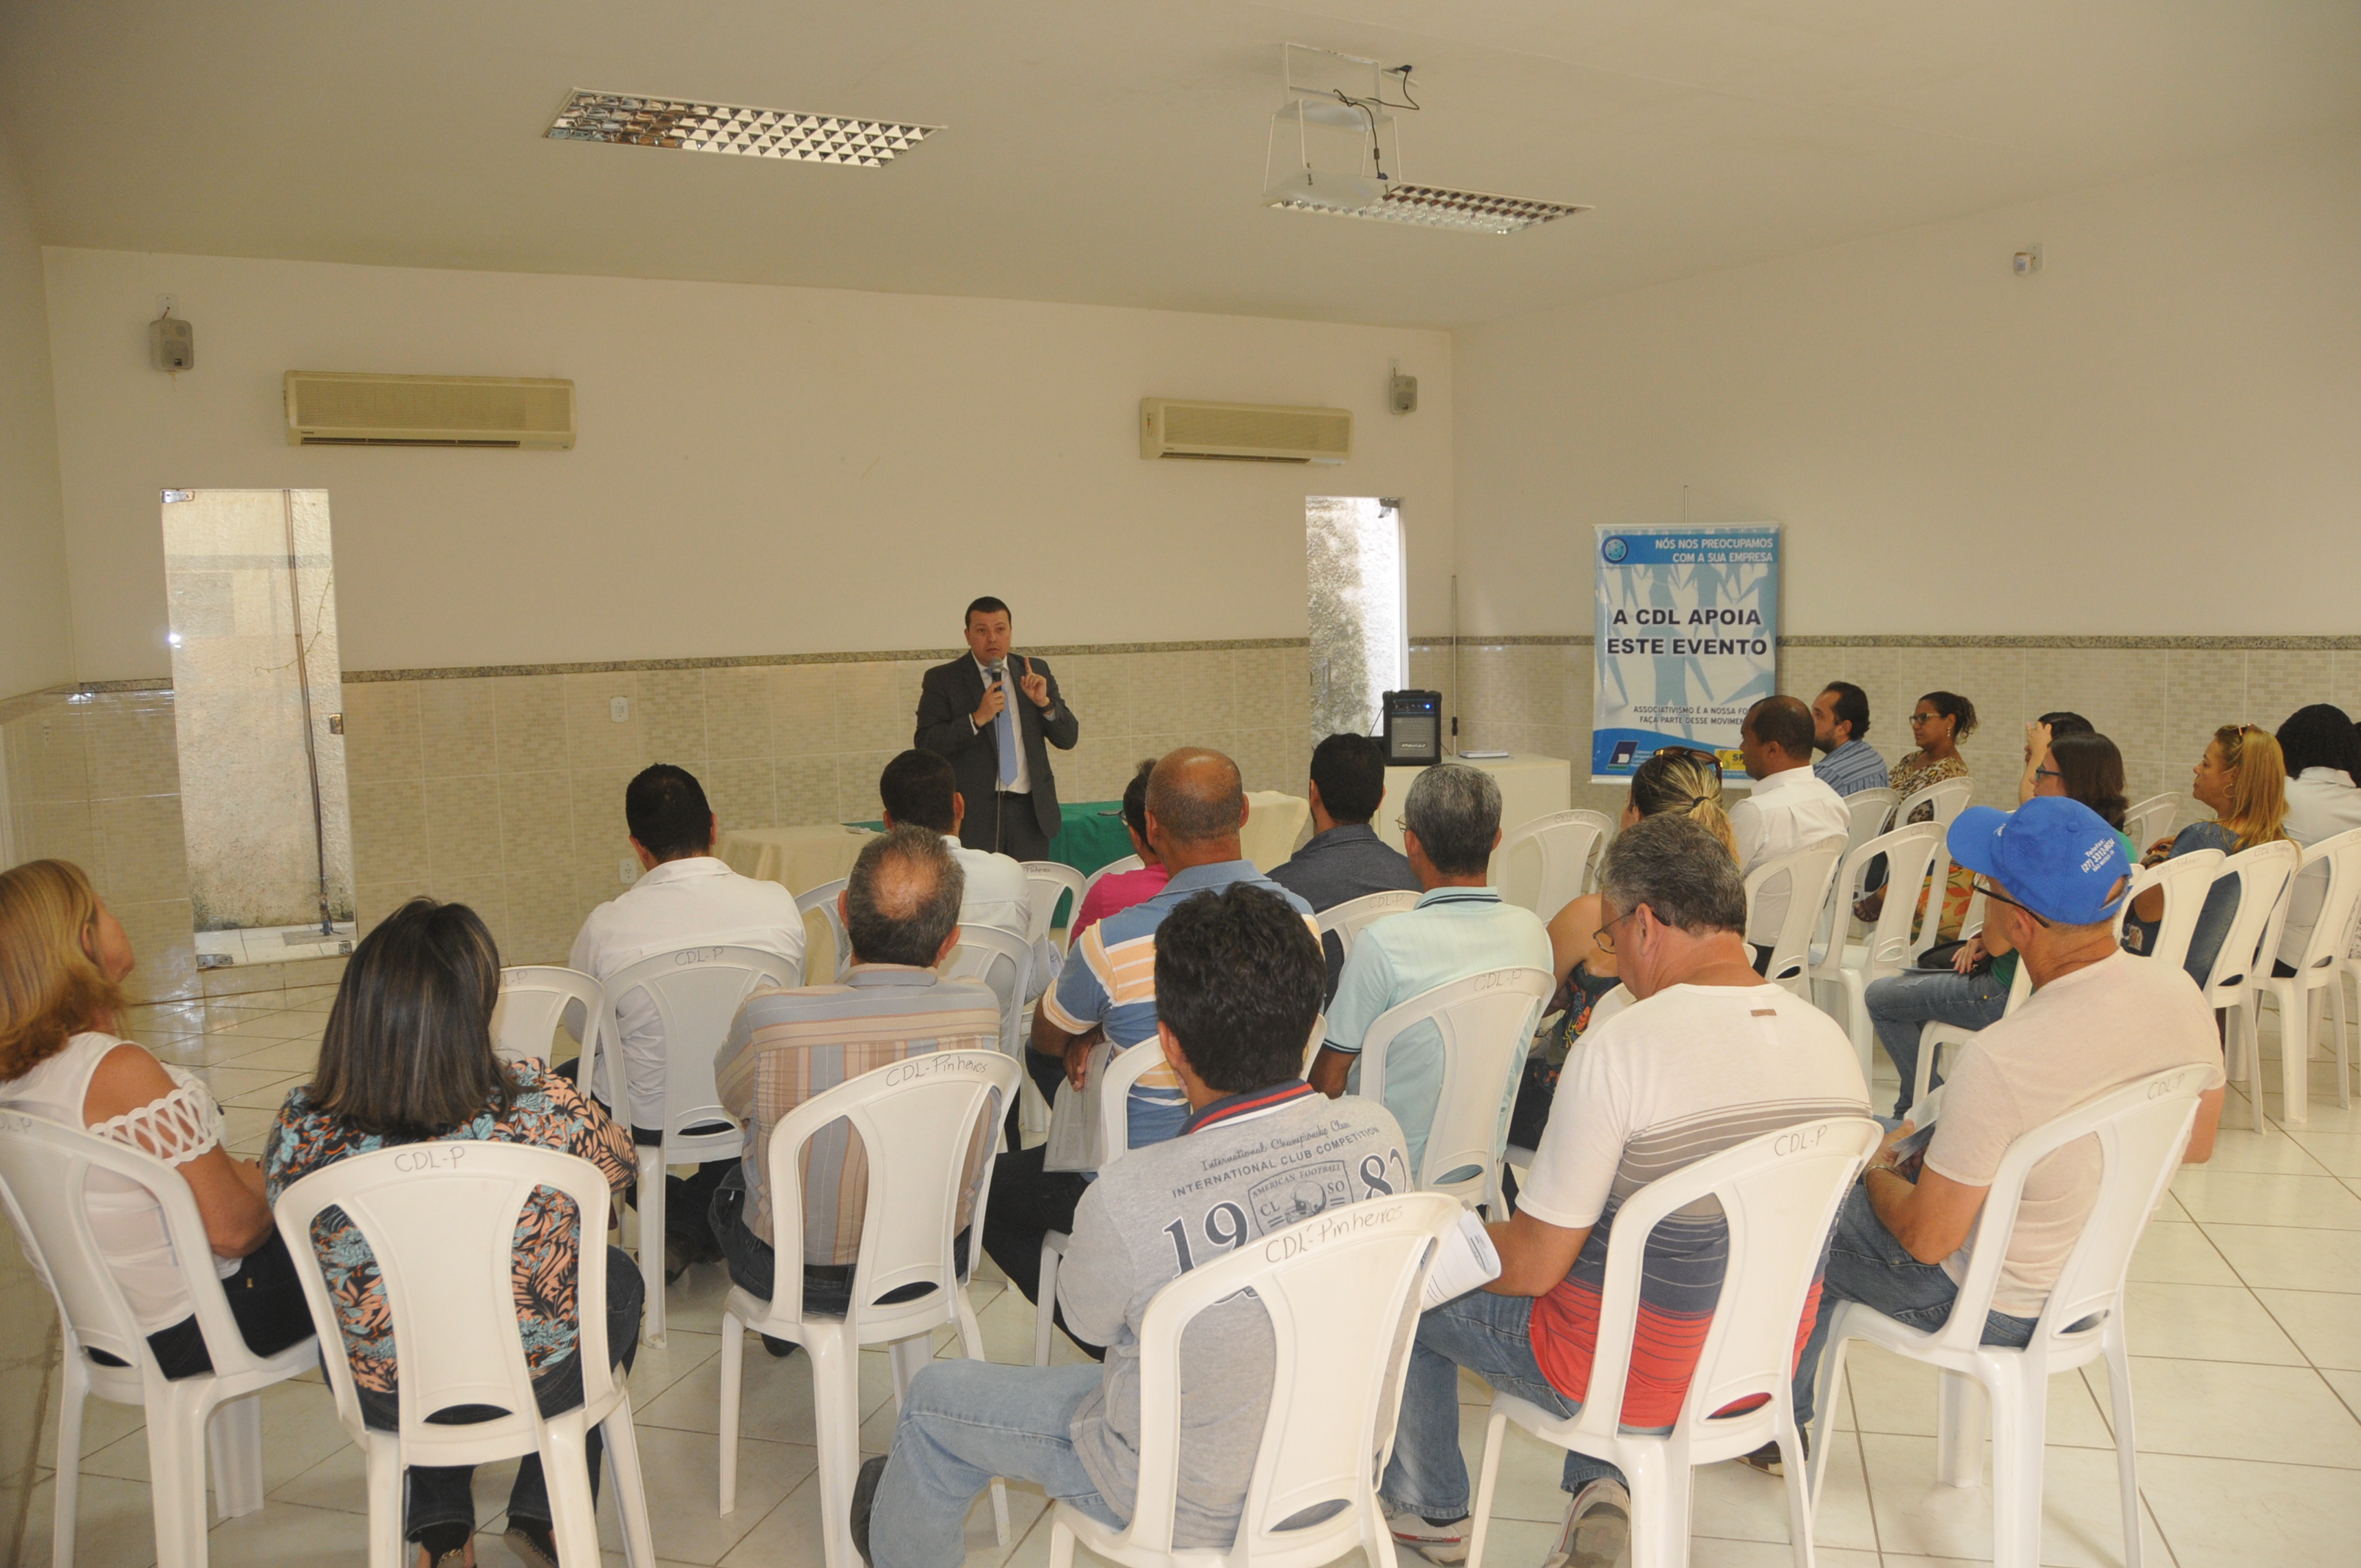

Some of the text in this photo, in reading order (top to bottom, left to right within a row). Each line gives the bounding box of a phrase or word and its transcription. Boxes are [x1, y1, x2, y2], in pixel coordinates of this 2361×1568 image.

[1655, 537, 1774, 549] NÓS NOS PREOCUPAMOS
[1672, 552, 1774, 562] COM A SUA EMPRESA
[1613, 609, 1762, 625] A CDL APOIA
[1607, 638, 1768, 655] ESTE EVENTO
[1633, 706, 1694, 714] ASSOCIATIVISMO
[1697, 705, 1701, 714] É
[1711, 707, 1736, 715] NOSSA
[1738, 707, 1749, 715] FO
[675, 946, 724, 966] CDL-P
[394, 1146, 465, 1172] CDL-P
[1172, 1126, 1380, 1199] INTERNATIONAL CLUB COMPETITION
[1200, 1142, 1267, 1172] International
[1252, 1163, 1342, 1198] AMERICAN FOOTBALL
[1327, 1180, 1346, 1195] SO
[1260, 1201, 1280, 1217] CL
